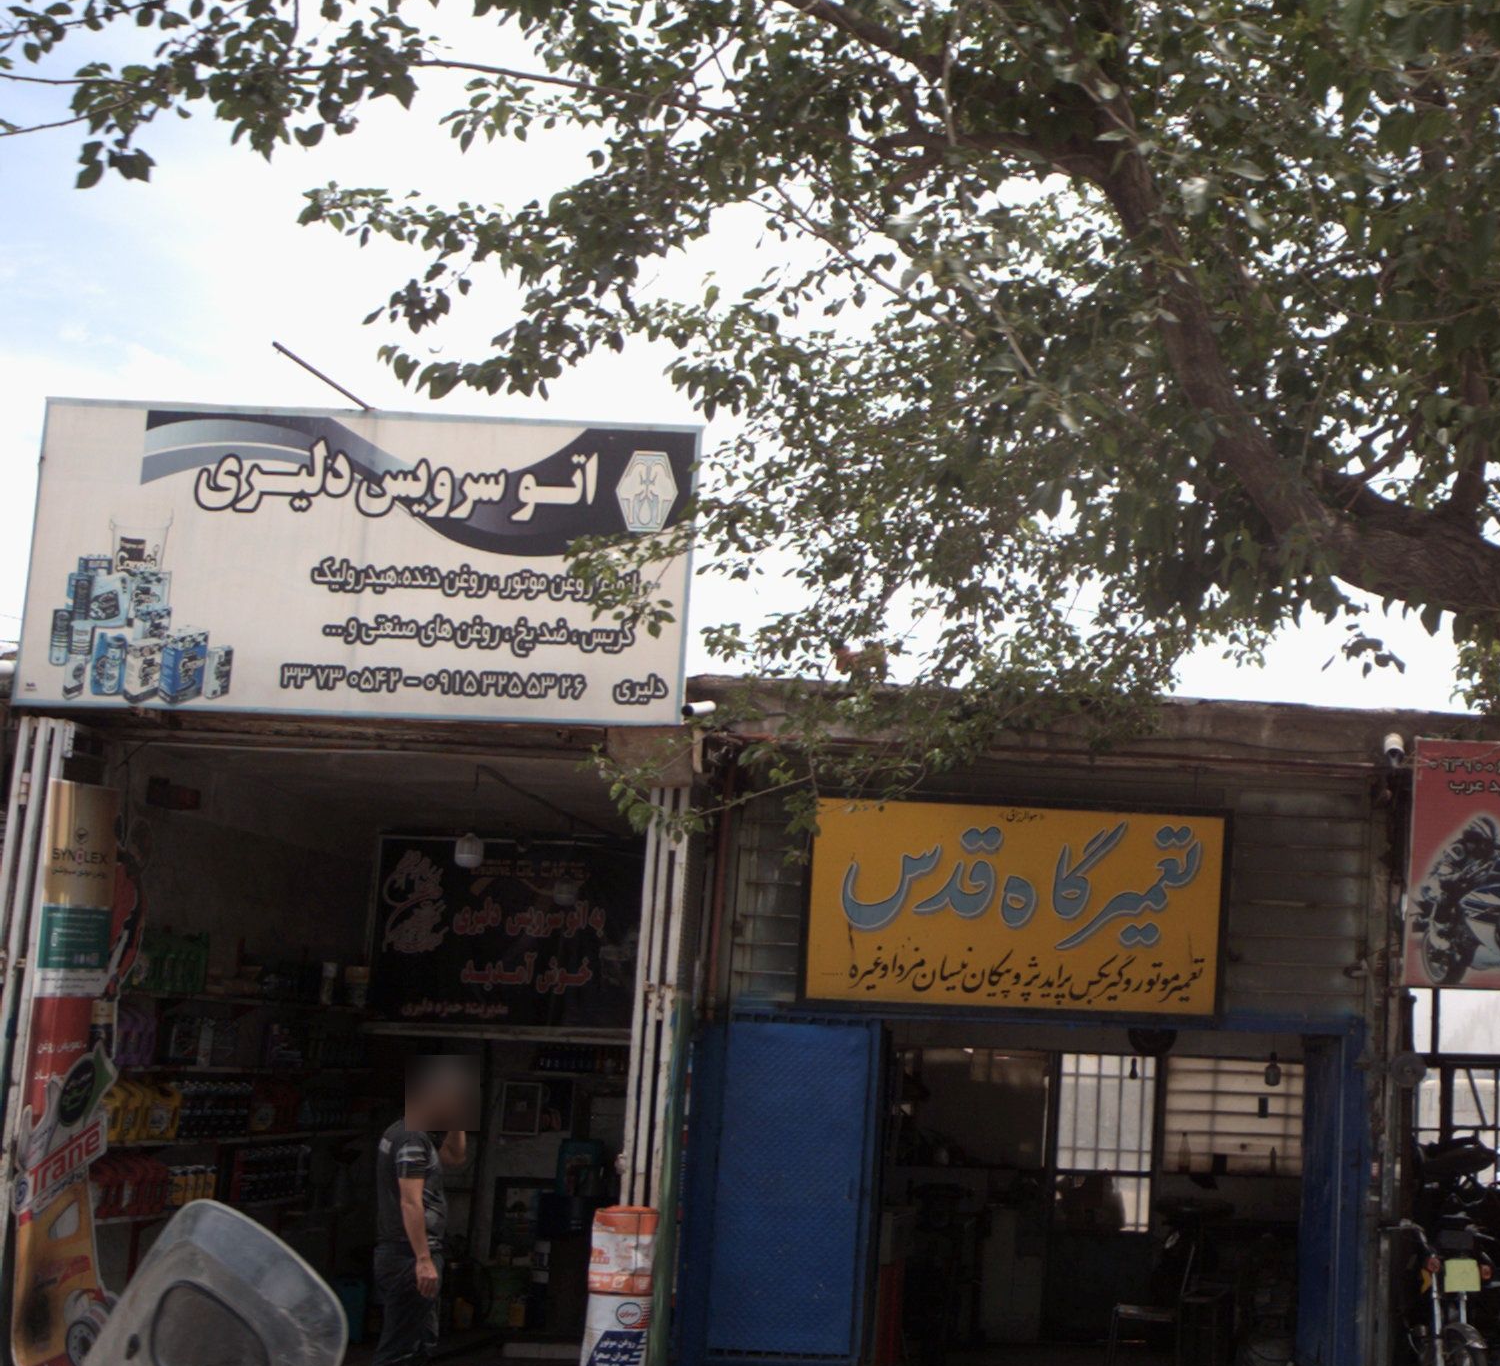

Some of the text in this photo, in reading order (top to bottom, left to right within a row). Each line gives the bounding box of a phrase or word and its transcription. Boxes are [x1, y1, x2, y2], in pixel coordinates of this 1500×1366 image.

[194, 437, 598, 522] اتو سرویس دلیری
[311, 556, 399, 595] هیدرولیک
[443, 563, 489, 596] روغن
[358, 613, 418, 646] صنعتی
[418, 613, 454, 647] های
[454, 615, 503, 648] روغن
[612, 672, 668, 705] دلیری
[1448, 779, 1485, 796] عرب
[841, 825, 1004, 932] قدس
[453, 896, 502, 937] دلیری
[505, 905, 566, 938] سرویس
[460, 951, 593, 995] خوش آمدید
[1038, 964, 1073, 1006] پراید
[1131, 962, 1181, 995] موتور
[1157, 957, 1206, 1004] تعمیر
